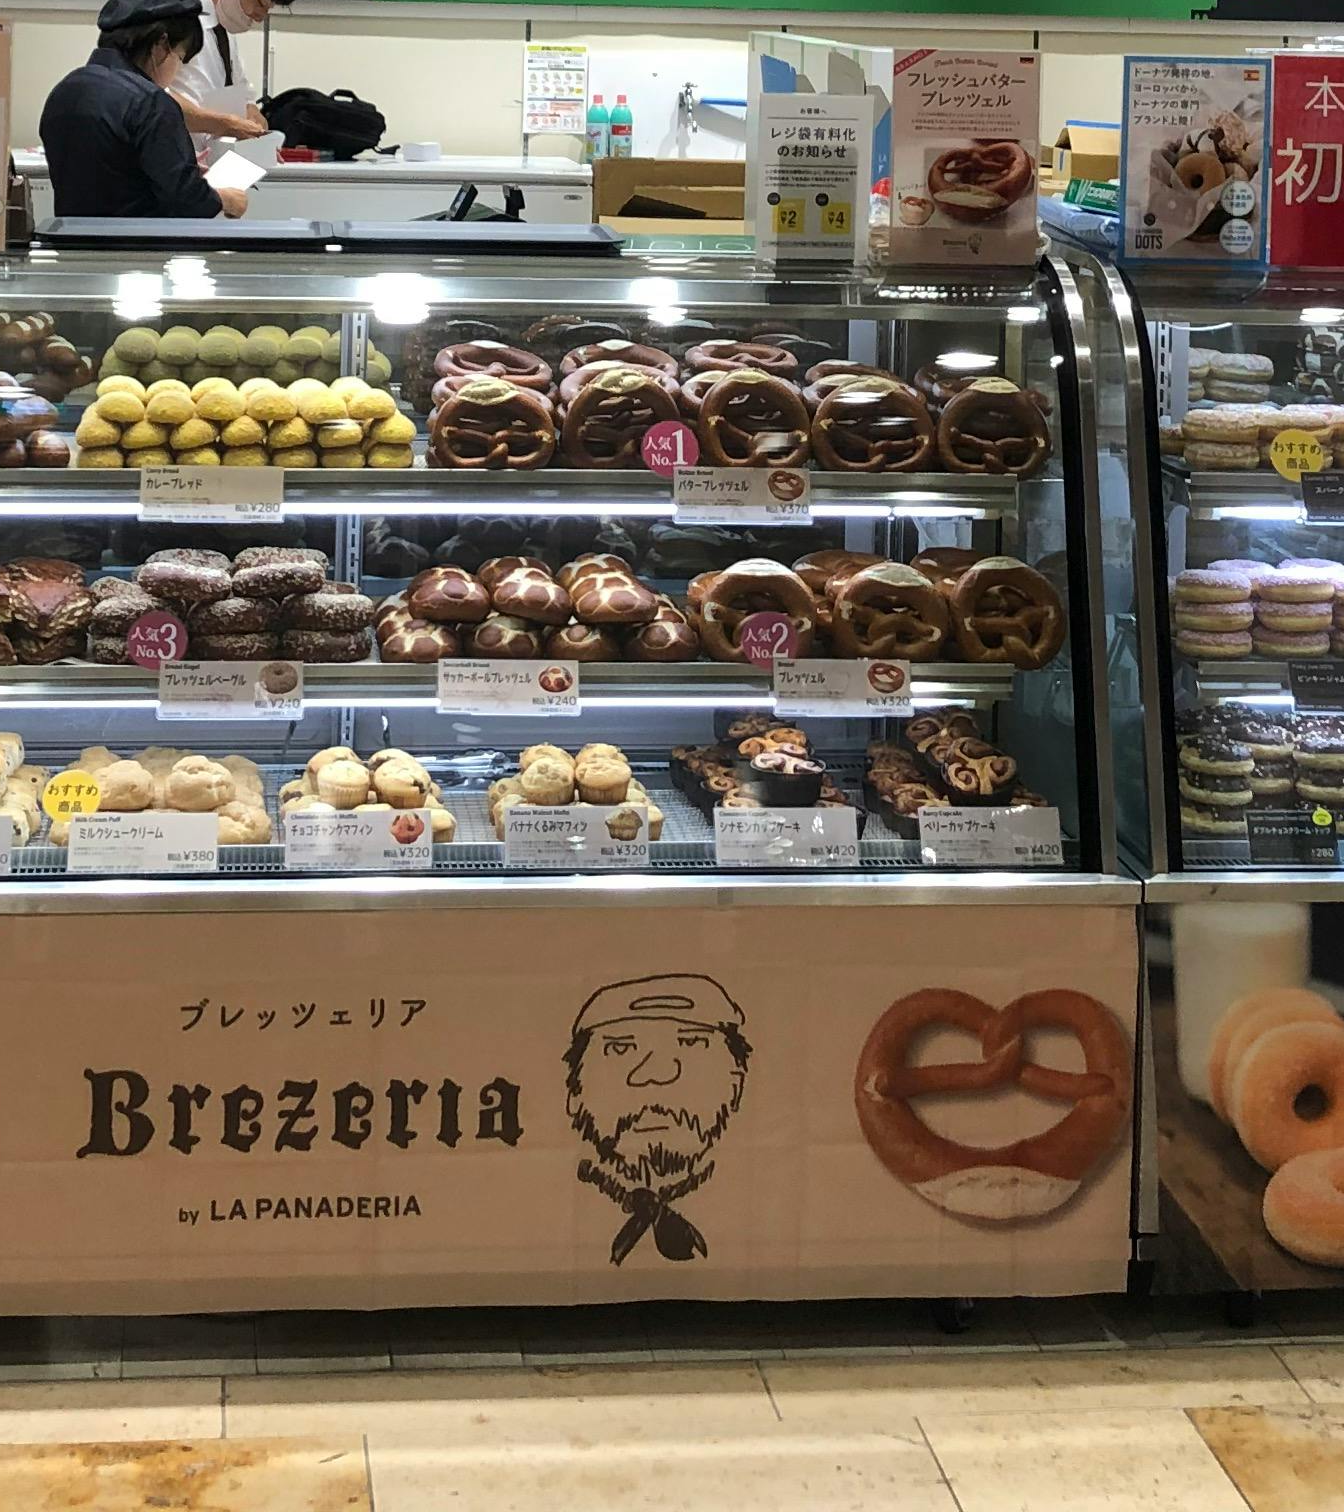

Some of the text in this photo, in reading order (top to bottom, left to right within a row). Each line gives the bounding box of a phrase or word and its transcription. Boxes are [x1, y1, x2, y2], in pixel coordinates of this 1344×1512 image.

[907, 72, 1026, 89] フレッシュバター
[1133, 99, 1200, 110] ドーナツの専門
[771, 127, 856, 142] レジ袋有料化
[777, 144, 847, 159] のお知らせ
[1136, 234, 1163, 250] DOTS
[645, 436, 672, 451] 人気
[671, 429, 688, 465] 1
[1273, 442, 1321, 455] おすすめ
[250, 502, 281, 513] ¥280
[780, 504, 809, 514] ¥370
[131, 626, 159, 642] 人気
[744, 628, 772, 642] 人気
[771, 622, 789, 658] 2
[157, 623, 177, 660] 3
[547, 695, 577, 706] ¥240
[880, 695, 910, 706] ¥320
[48, 784, 98, 796] おすすめ
[58, 800, 82, 812] 商品
[509, 820, 588, 833] バナナくるみマフィン
[923, 820, 996, 832] ベリーカップケーキ
[78, 827, 164, 839] ミルクシュークリーム
[183, 850, 214, 861] ¥380
[399, 847, 430, 858] ¥320
[616, 844, 646, 855] ¥320
[825, 844, 856, 856] ¥420
[1030, 844, 1059, 856] ¥420
[180, 998, 427, 1032] ブレッツェリア
[75, 1068, 525, 1159] Brezeria
[178, 1194, 422, 1226] by LA PANADERIA
